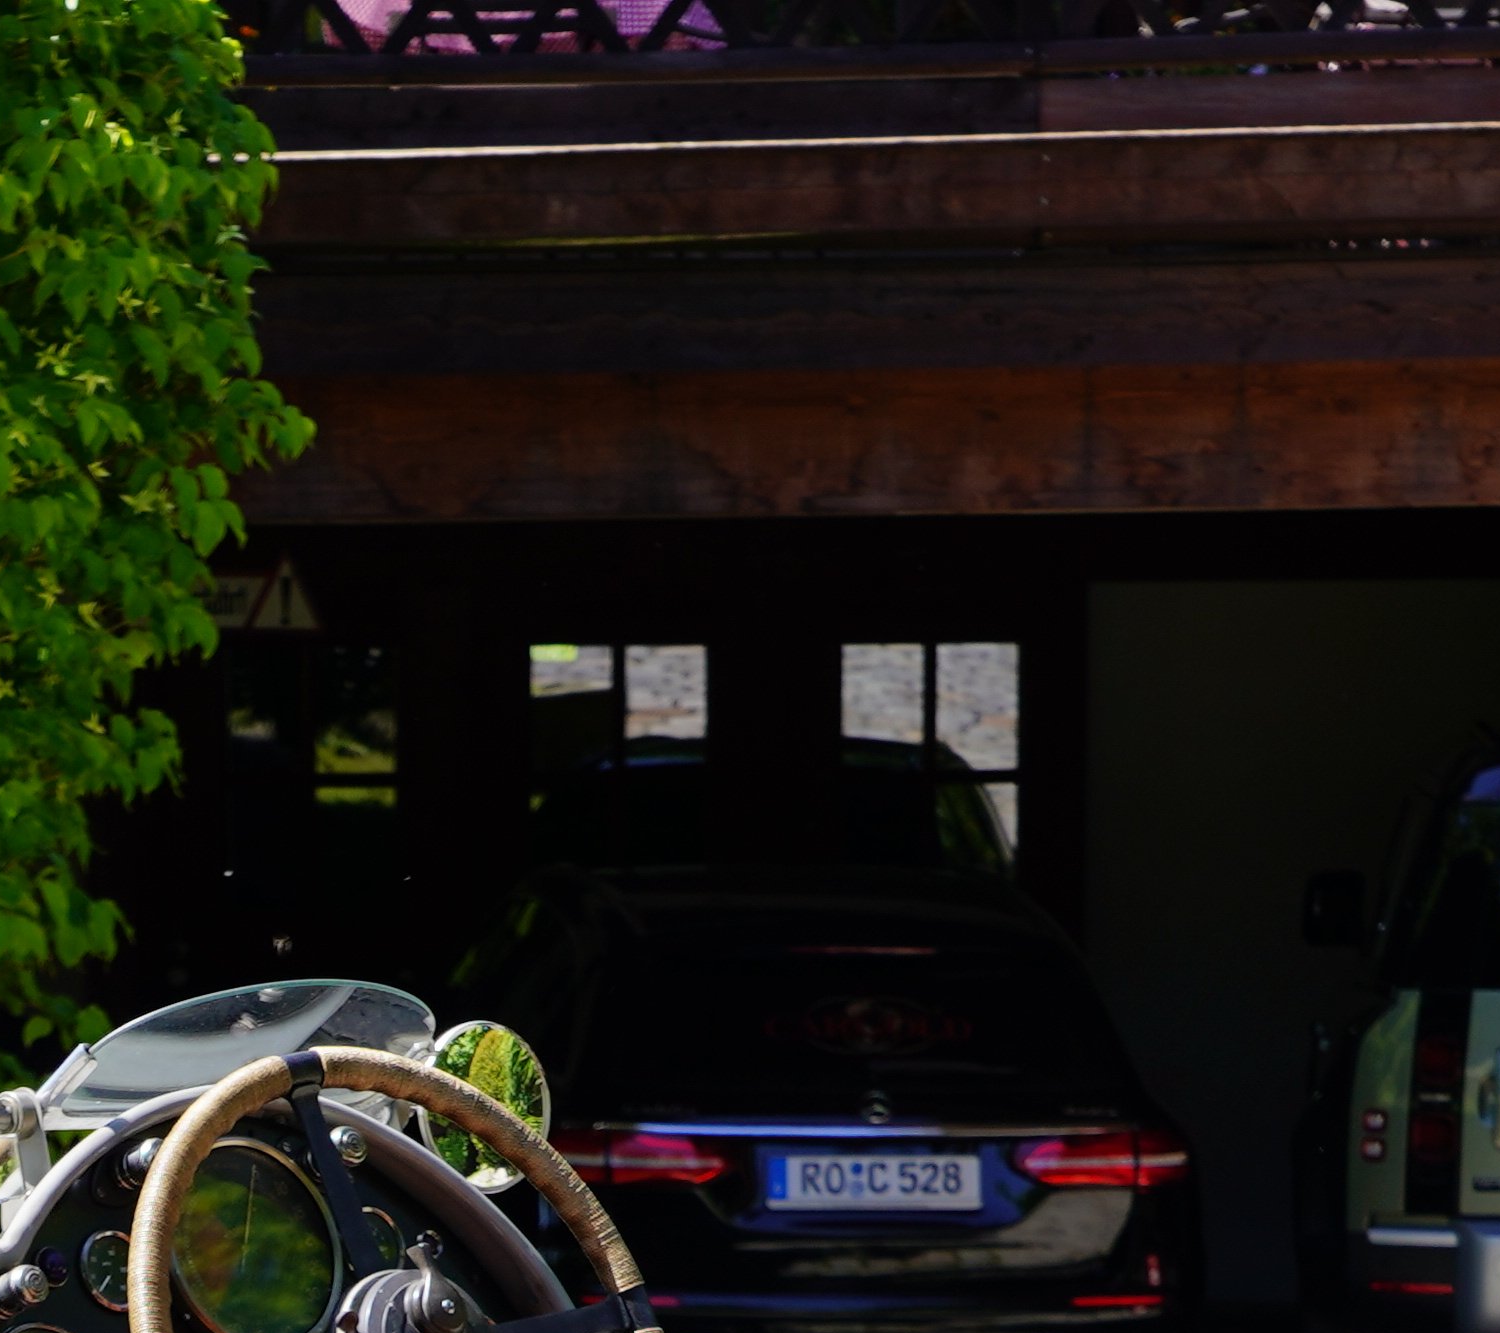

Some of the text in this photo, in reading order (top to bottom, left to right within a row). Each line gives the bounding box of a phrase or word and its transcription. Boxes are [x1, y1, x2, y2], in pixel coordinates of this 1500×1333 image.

[802, 1163, 962, 1196] RO C 528
